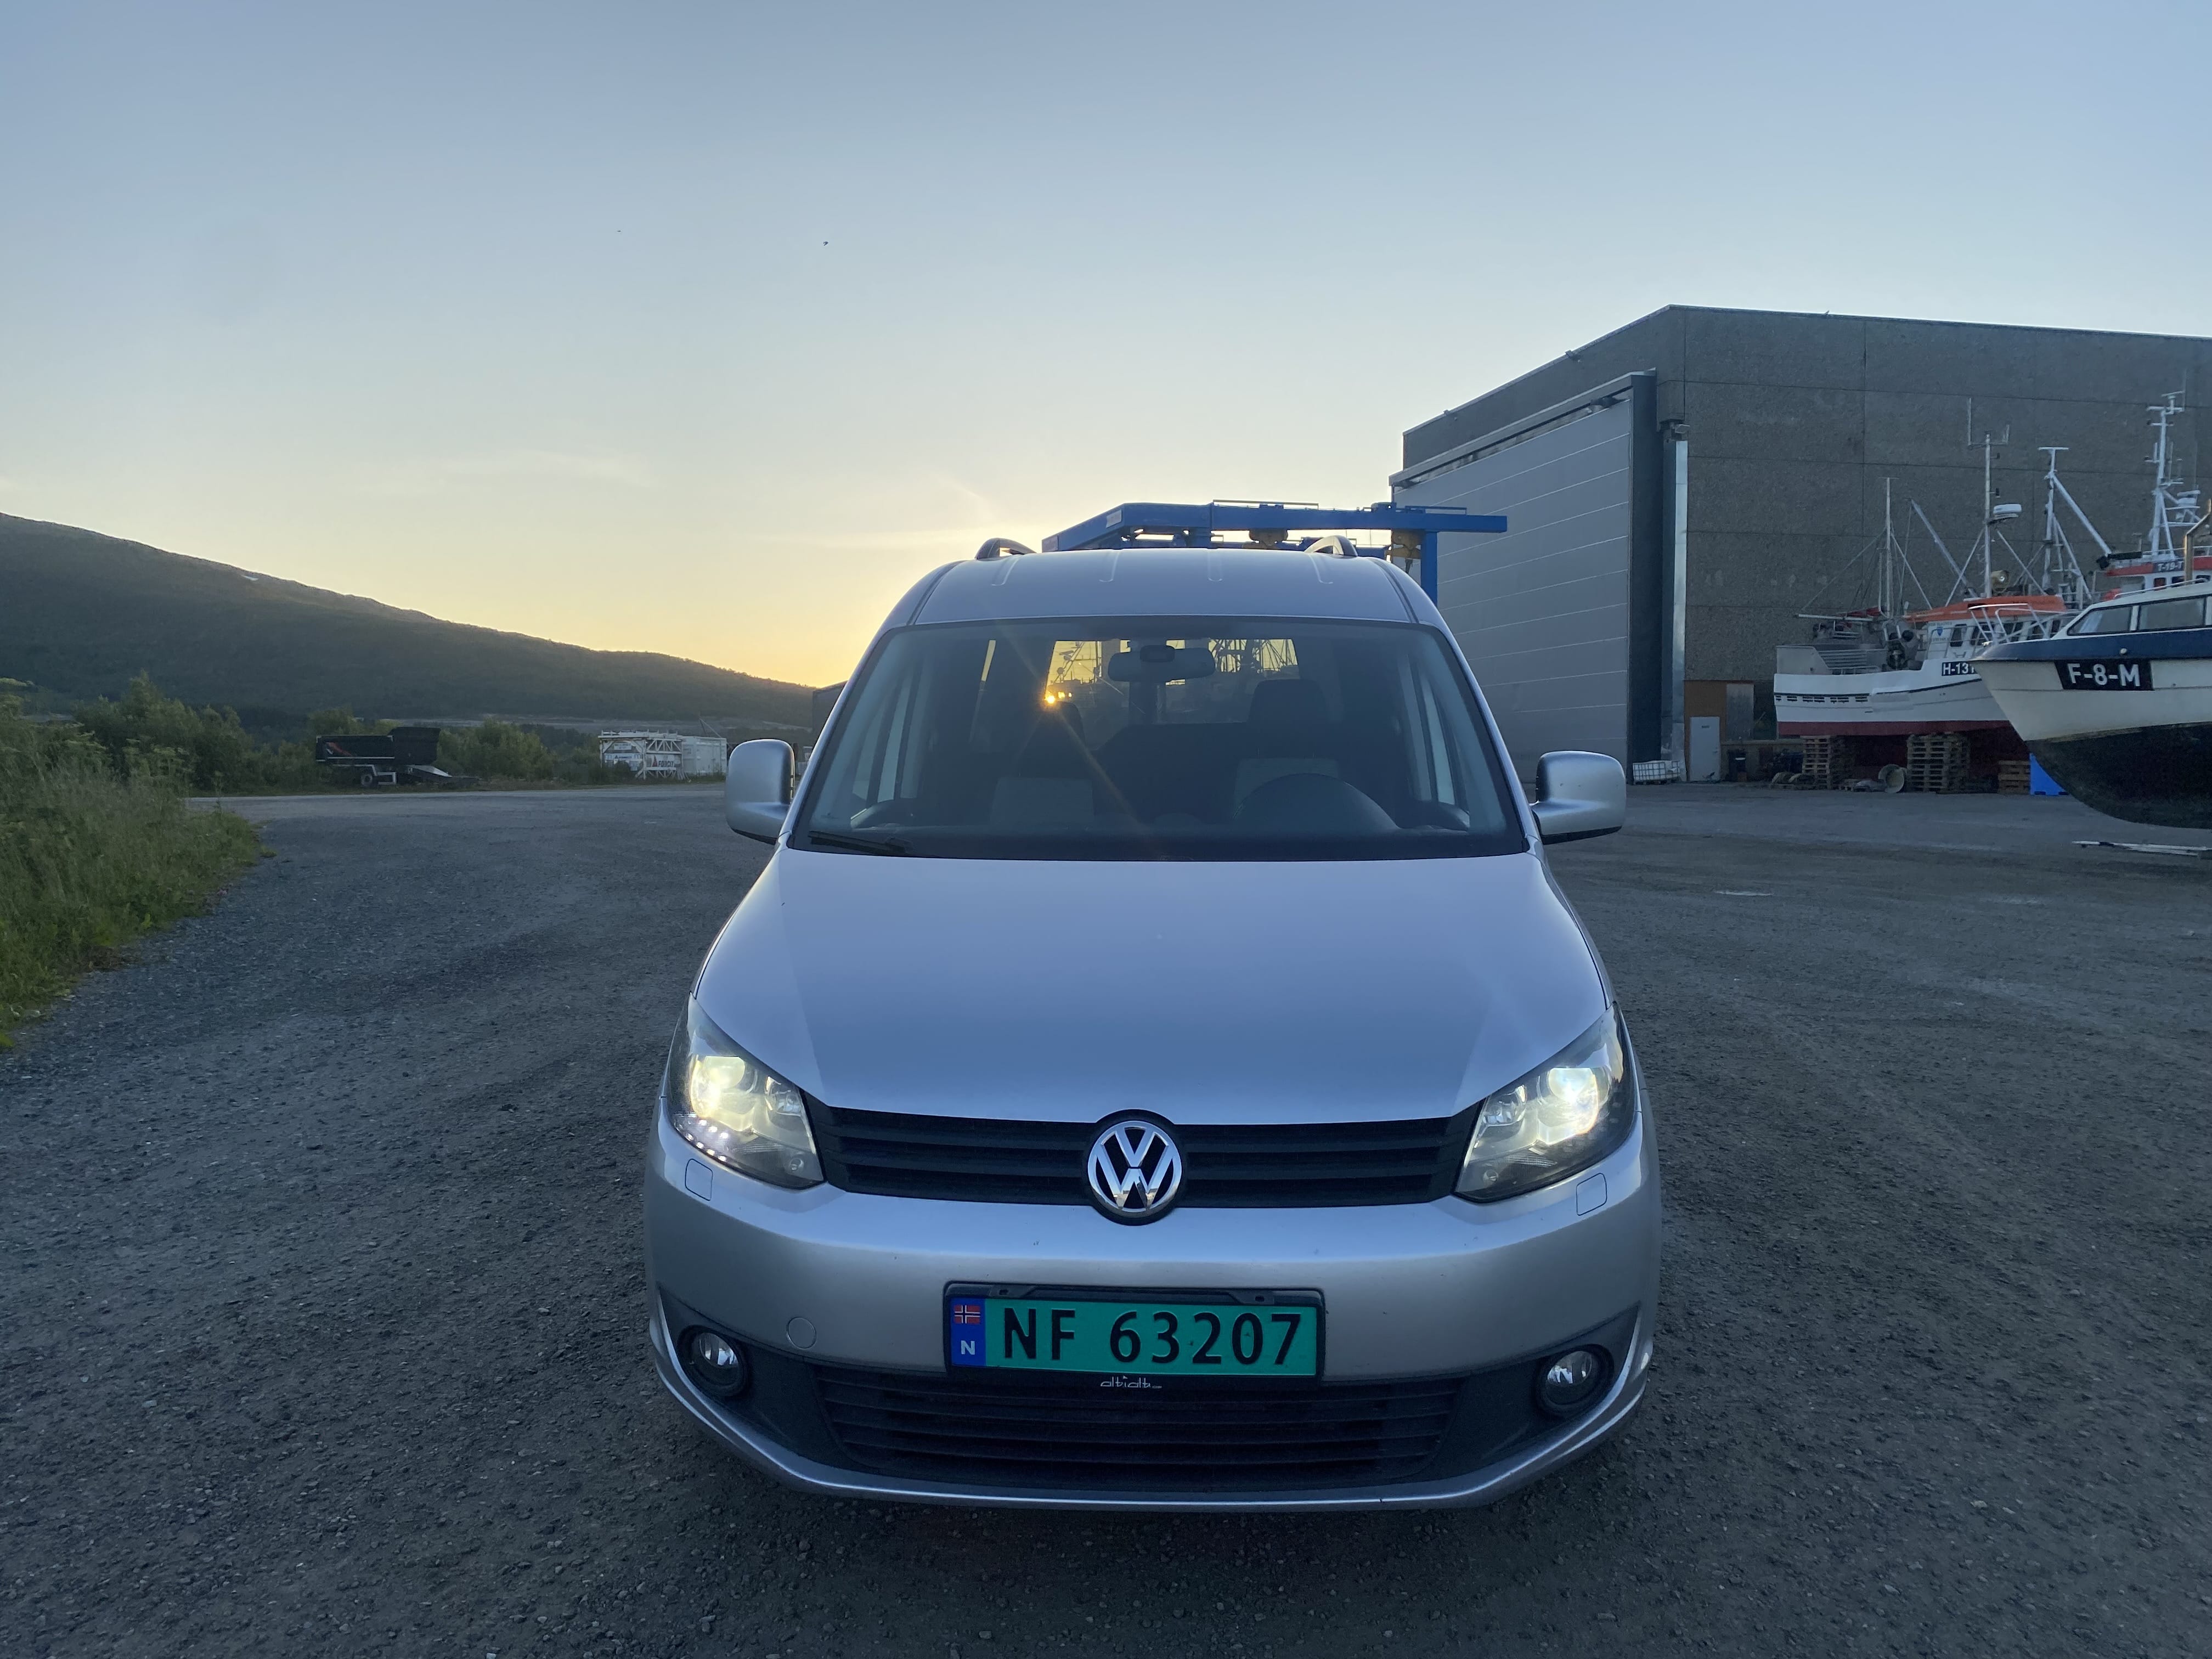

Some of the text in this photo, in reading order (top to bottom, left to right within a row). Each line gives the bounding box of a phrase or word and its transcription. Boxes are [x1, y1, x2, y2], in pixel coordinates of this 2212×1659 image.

[2067, 663, 2141, 687] F-8-M
[1088, 1121, 1182, 1217] VW
[961, 1340, 975, 1355] N
[1004, 1307, 1302, 1365] NF 63207
